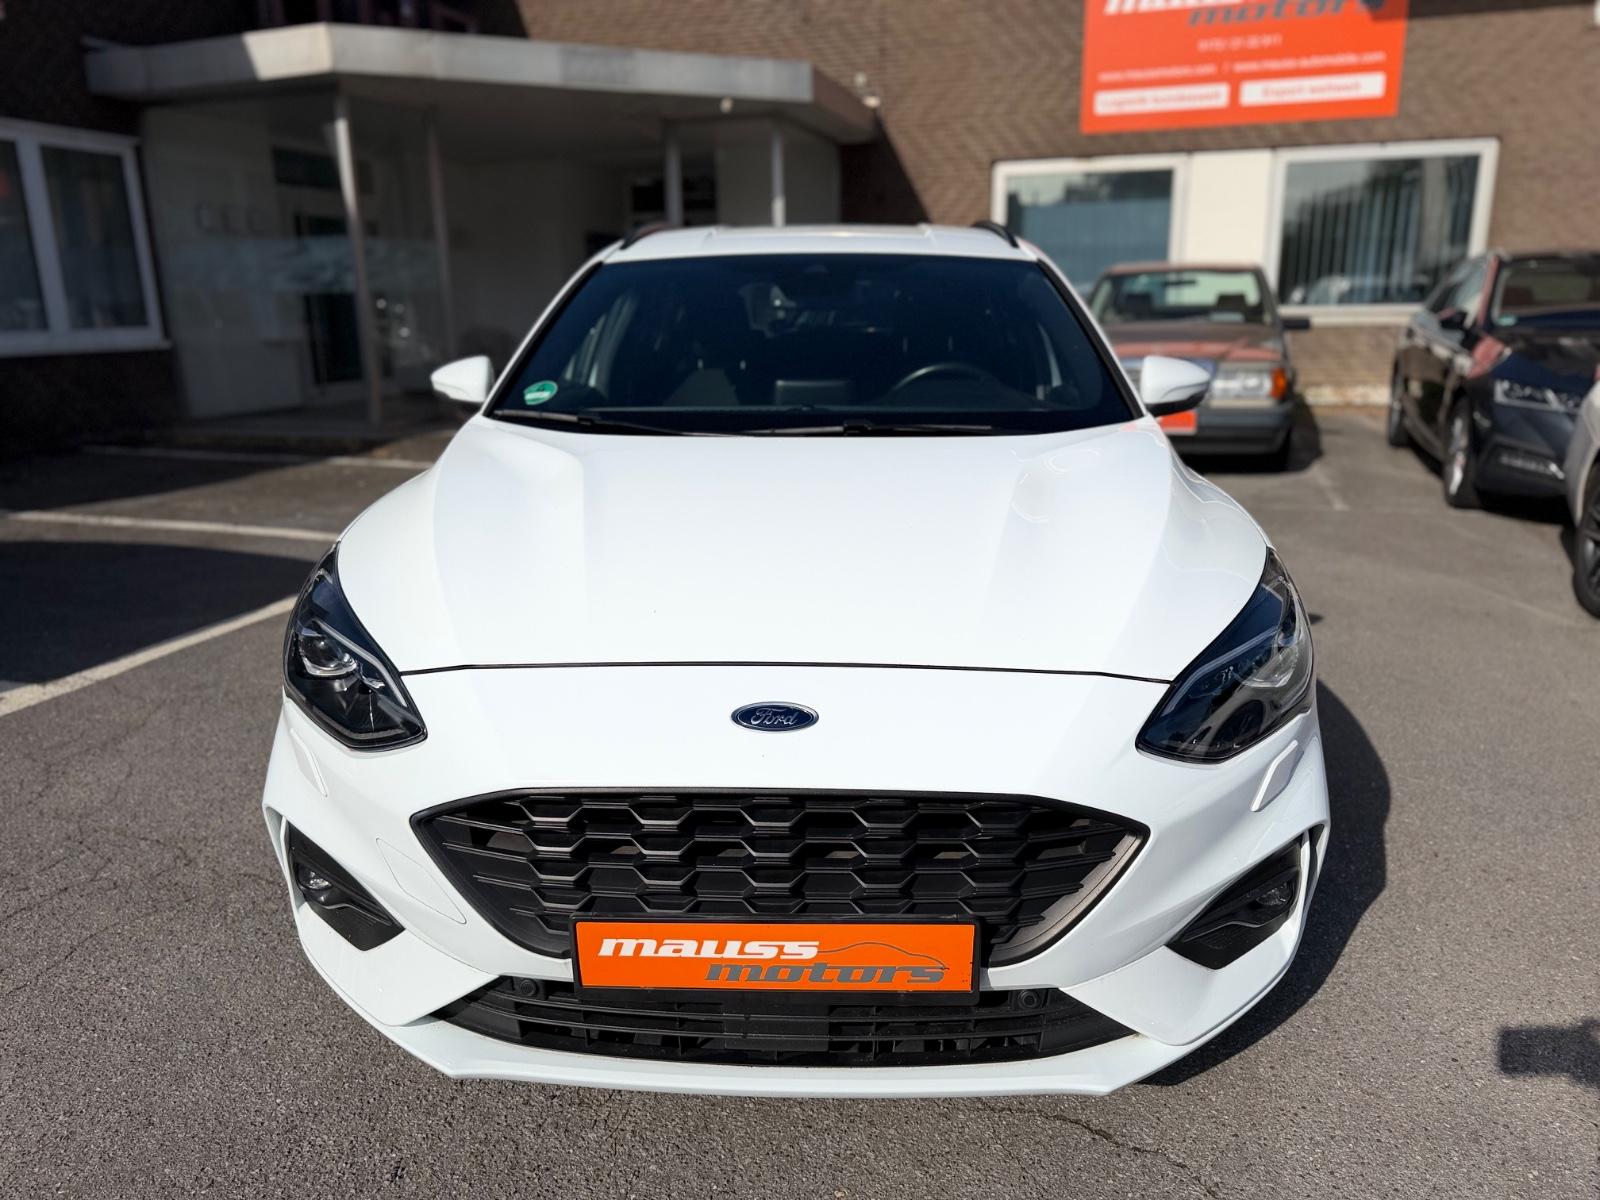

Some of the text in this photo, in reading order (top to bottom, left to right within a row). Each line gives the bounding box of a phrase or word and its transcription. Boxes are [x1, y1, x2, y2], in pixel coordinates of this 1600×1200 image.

[750, 706, 799, 725] Ford
[598, 938, 820, 960] mauss
[704, 961, 946, 985] motors
